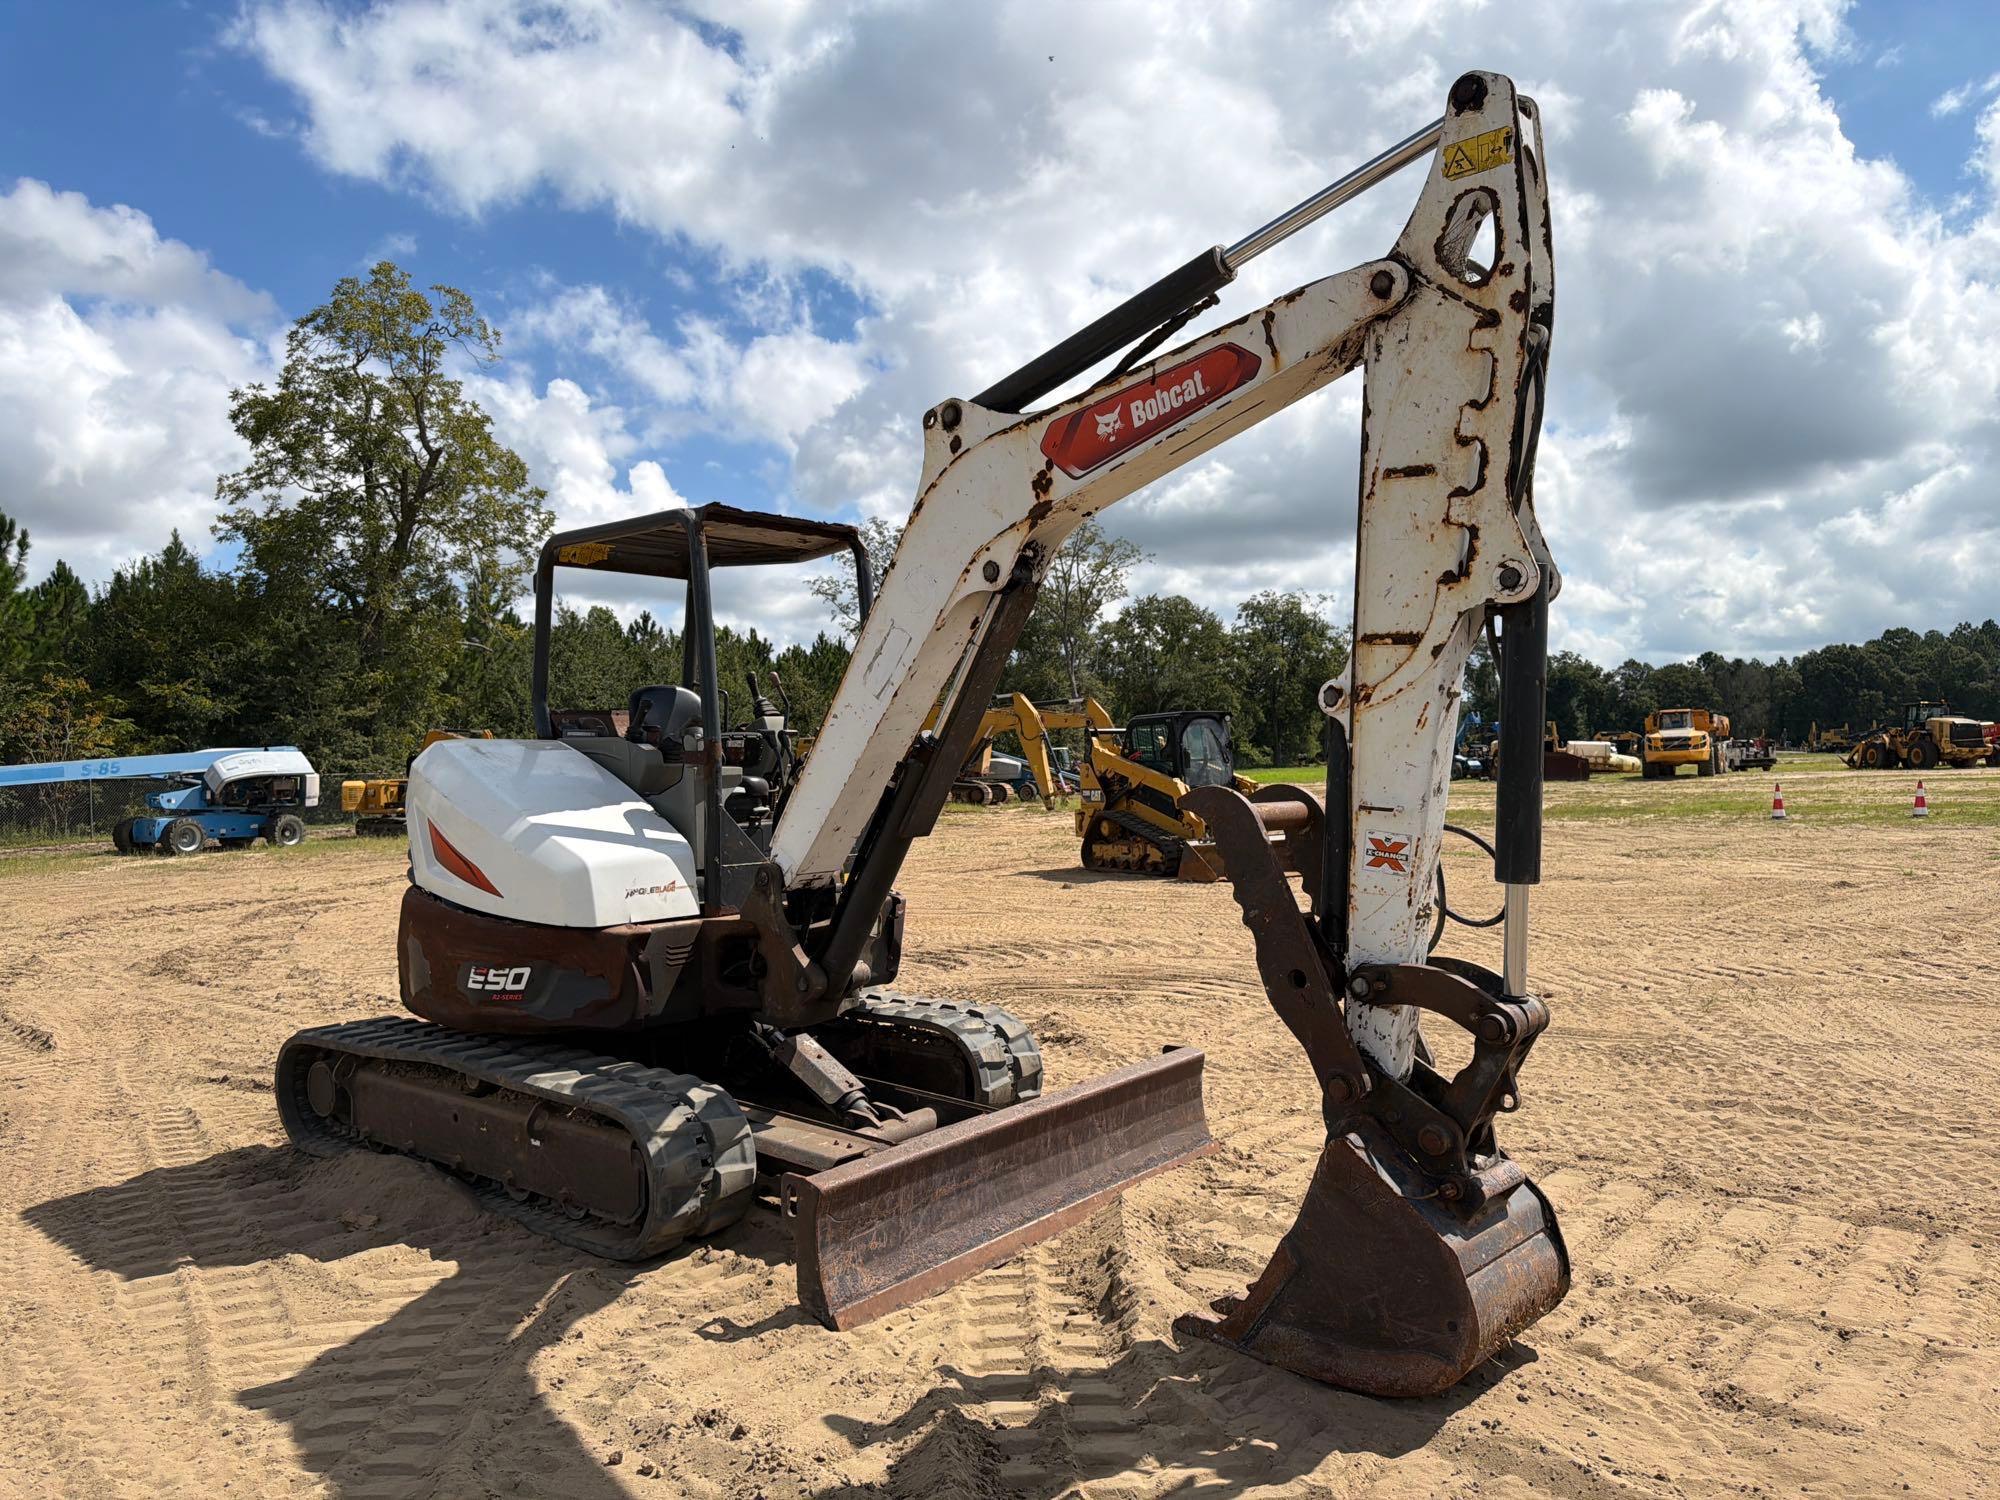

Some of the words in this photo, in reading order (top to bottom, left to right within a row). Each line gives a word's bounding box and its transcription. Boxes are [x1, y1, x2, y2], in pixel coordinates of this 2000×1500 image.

[1130, 370, 1206, 428] Bobcat
[81, 761, 121, 777] S-85
[1367, 848, 1407, 861] X-CHANGE
[467, 965, 532, 991] E50
